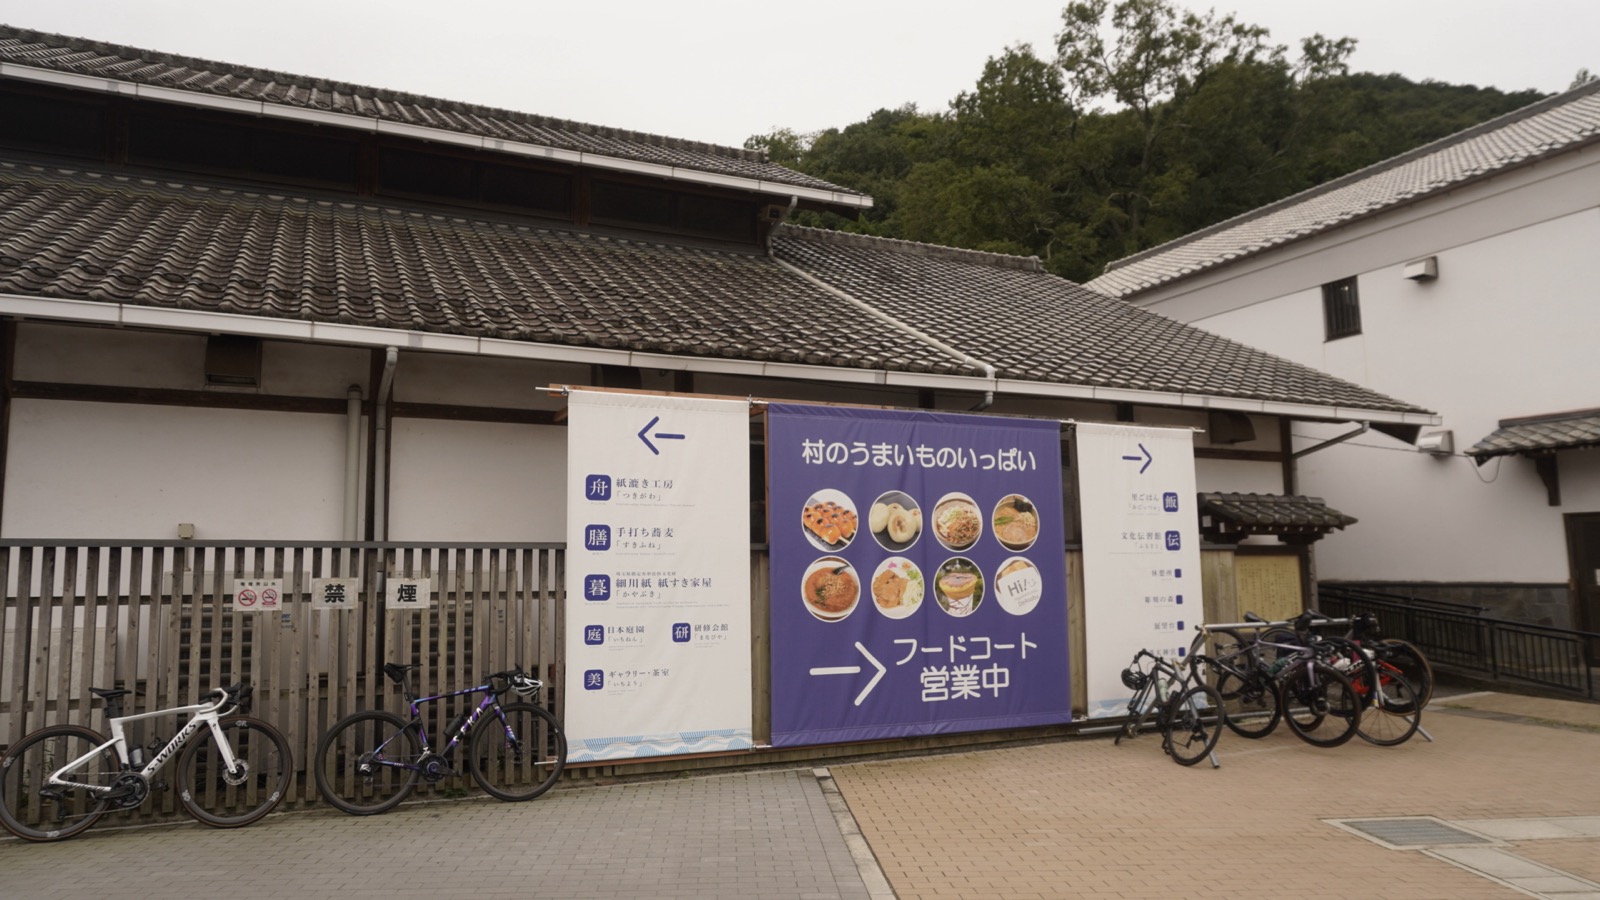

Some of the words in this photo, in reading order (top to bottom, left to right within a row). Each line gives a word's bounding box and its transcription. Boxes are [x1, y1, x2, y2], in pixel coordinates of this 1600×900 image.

[801, 438, 1037, 471] 村のうまいものいっぱい
[589, 478, 608, 497] 舟
[616, 478, 674, 490] 紙漉き工房
[616, 490, 662, 502] 「つきがわ」
[1164, 495, 1178, 509] 飯
[587, 528, 608, 546] 膳
[616, 527, 674, 538] 手打ち蕎麦
[1167, 534, 1180, 547] 伝
[589, 579, 609, 596] 暮
[615, 577, 652, 588] 細川紙
[657, 577, 712, 588] 紙すき家屋
[1007, 578, 1027, 597] Hi!
[324, 583, 345, 603] 禁
[397, 584, 417, 603] 煙
[587, 628, 602, 641] 庭
[607, 625, 645, 634] 日本庭園
[674, 626, 689, 640] 研
[694, 623, 729, 632] 研修会館
[893, 631, 1037, 666] フードコート
[587, 672, 601, 687] 美
[919, 662, 1010, 702] 営業中
[146, 723, 197, 773] S-WORKS
